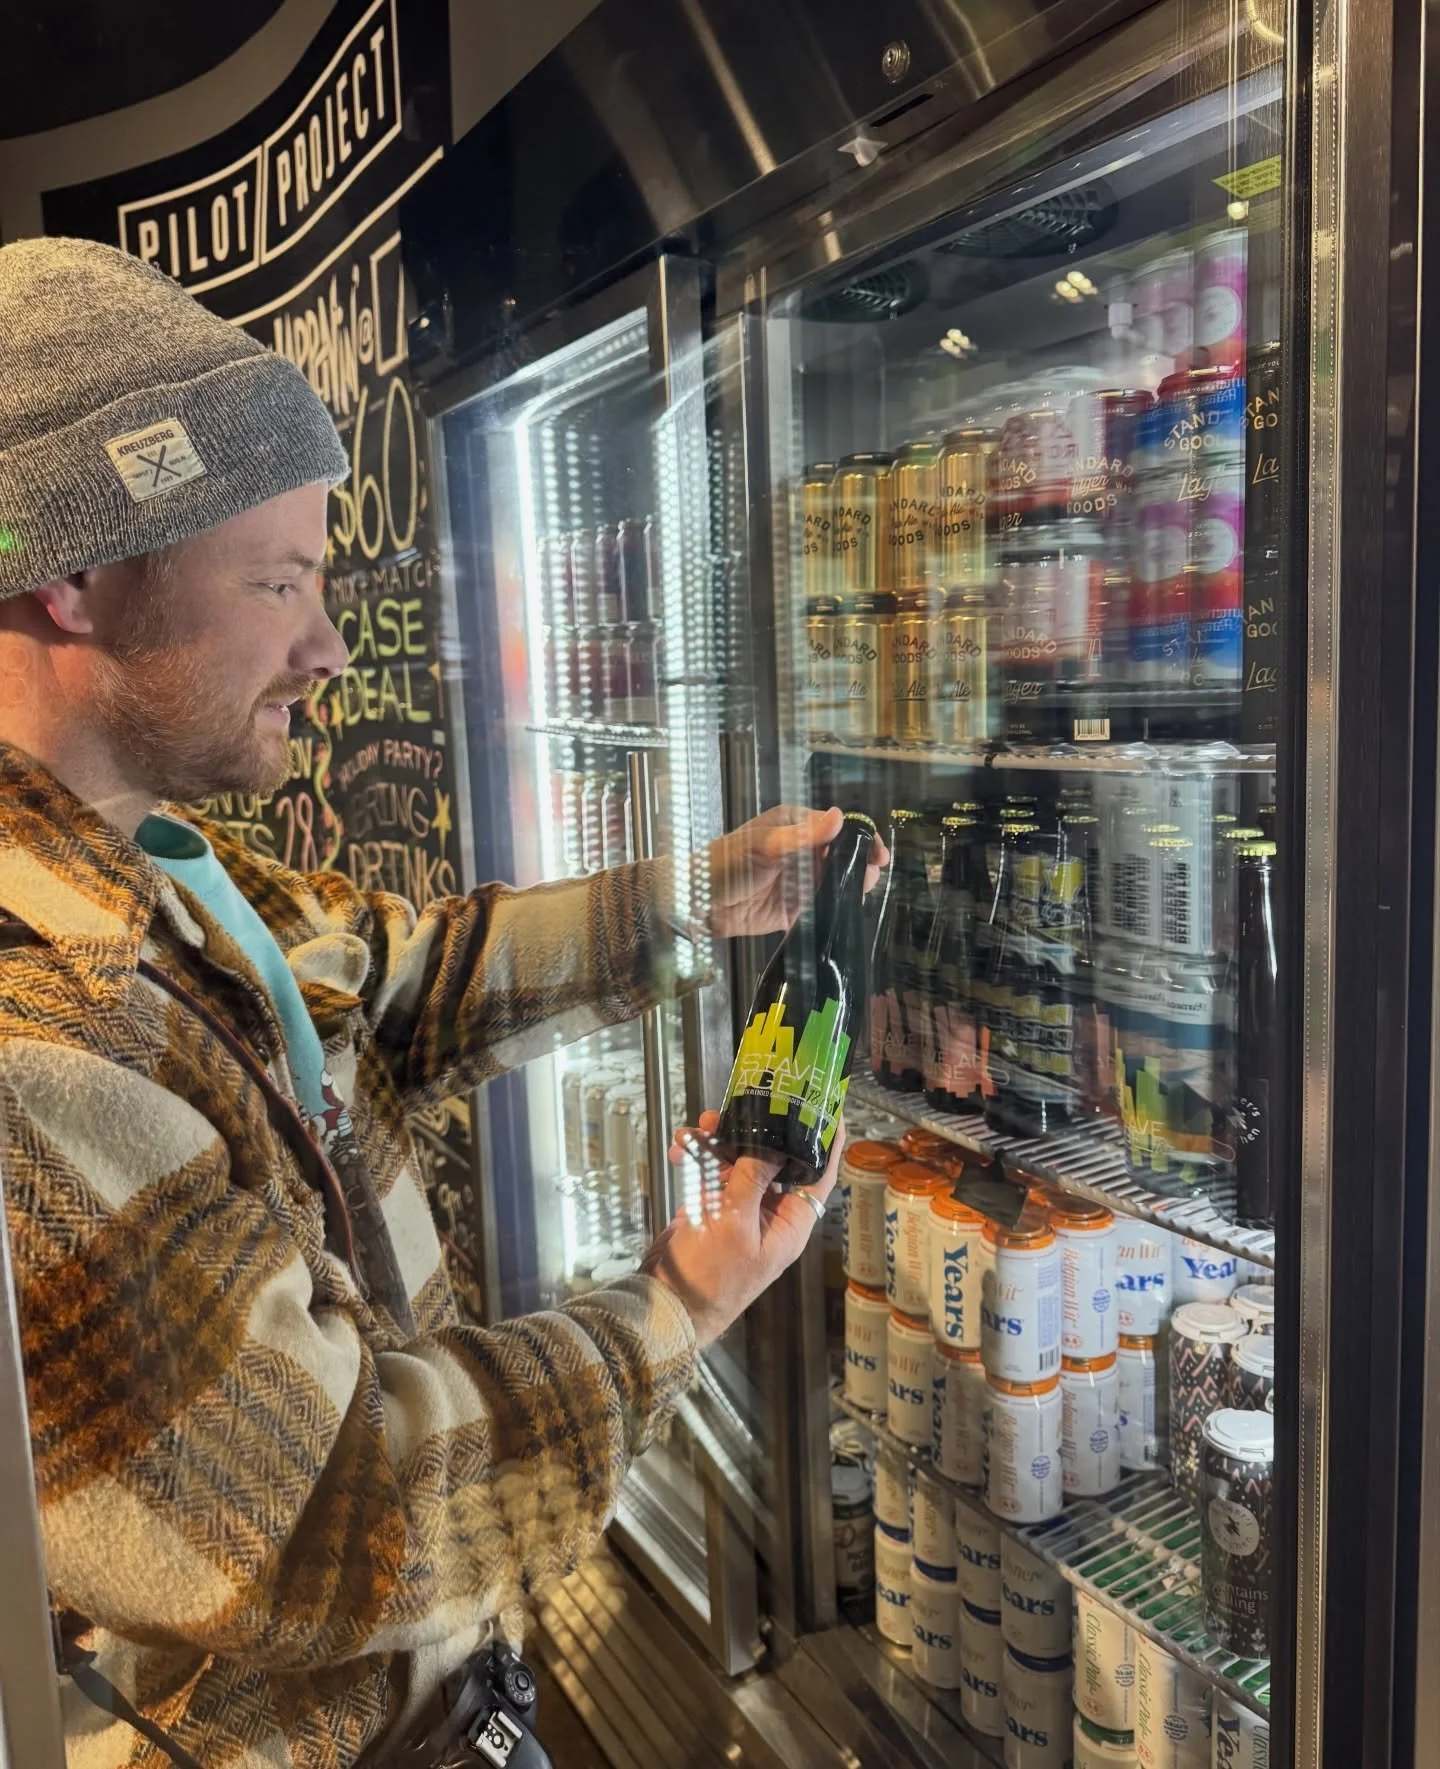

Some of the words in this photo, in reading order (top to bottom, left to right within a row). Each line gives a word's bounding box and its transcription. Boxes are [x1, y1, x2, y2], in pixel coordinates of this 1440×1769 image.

[138, 181, 249, 278] PILOT
[276, 25, 385, 227] PROJECT
[117, 428, 175, 457] KREUZBERG
[1179, 434, 1218, 451] GOO
[339, 597, 426, 662] CASE
[340, 664, 432, 726] DEAL
[382, 737, 444, 786] PARTY?
[347, 840, 456, 908] DRINKS
[733, 1070, 806, 1102] AGE
[740, 1052, 826, 1091] STAVE
[944, 1241, 969, 1346] Years
[1086, 1612, 1102, 1659] Classic
